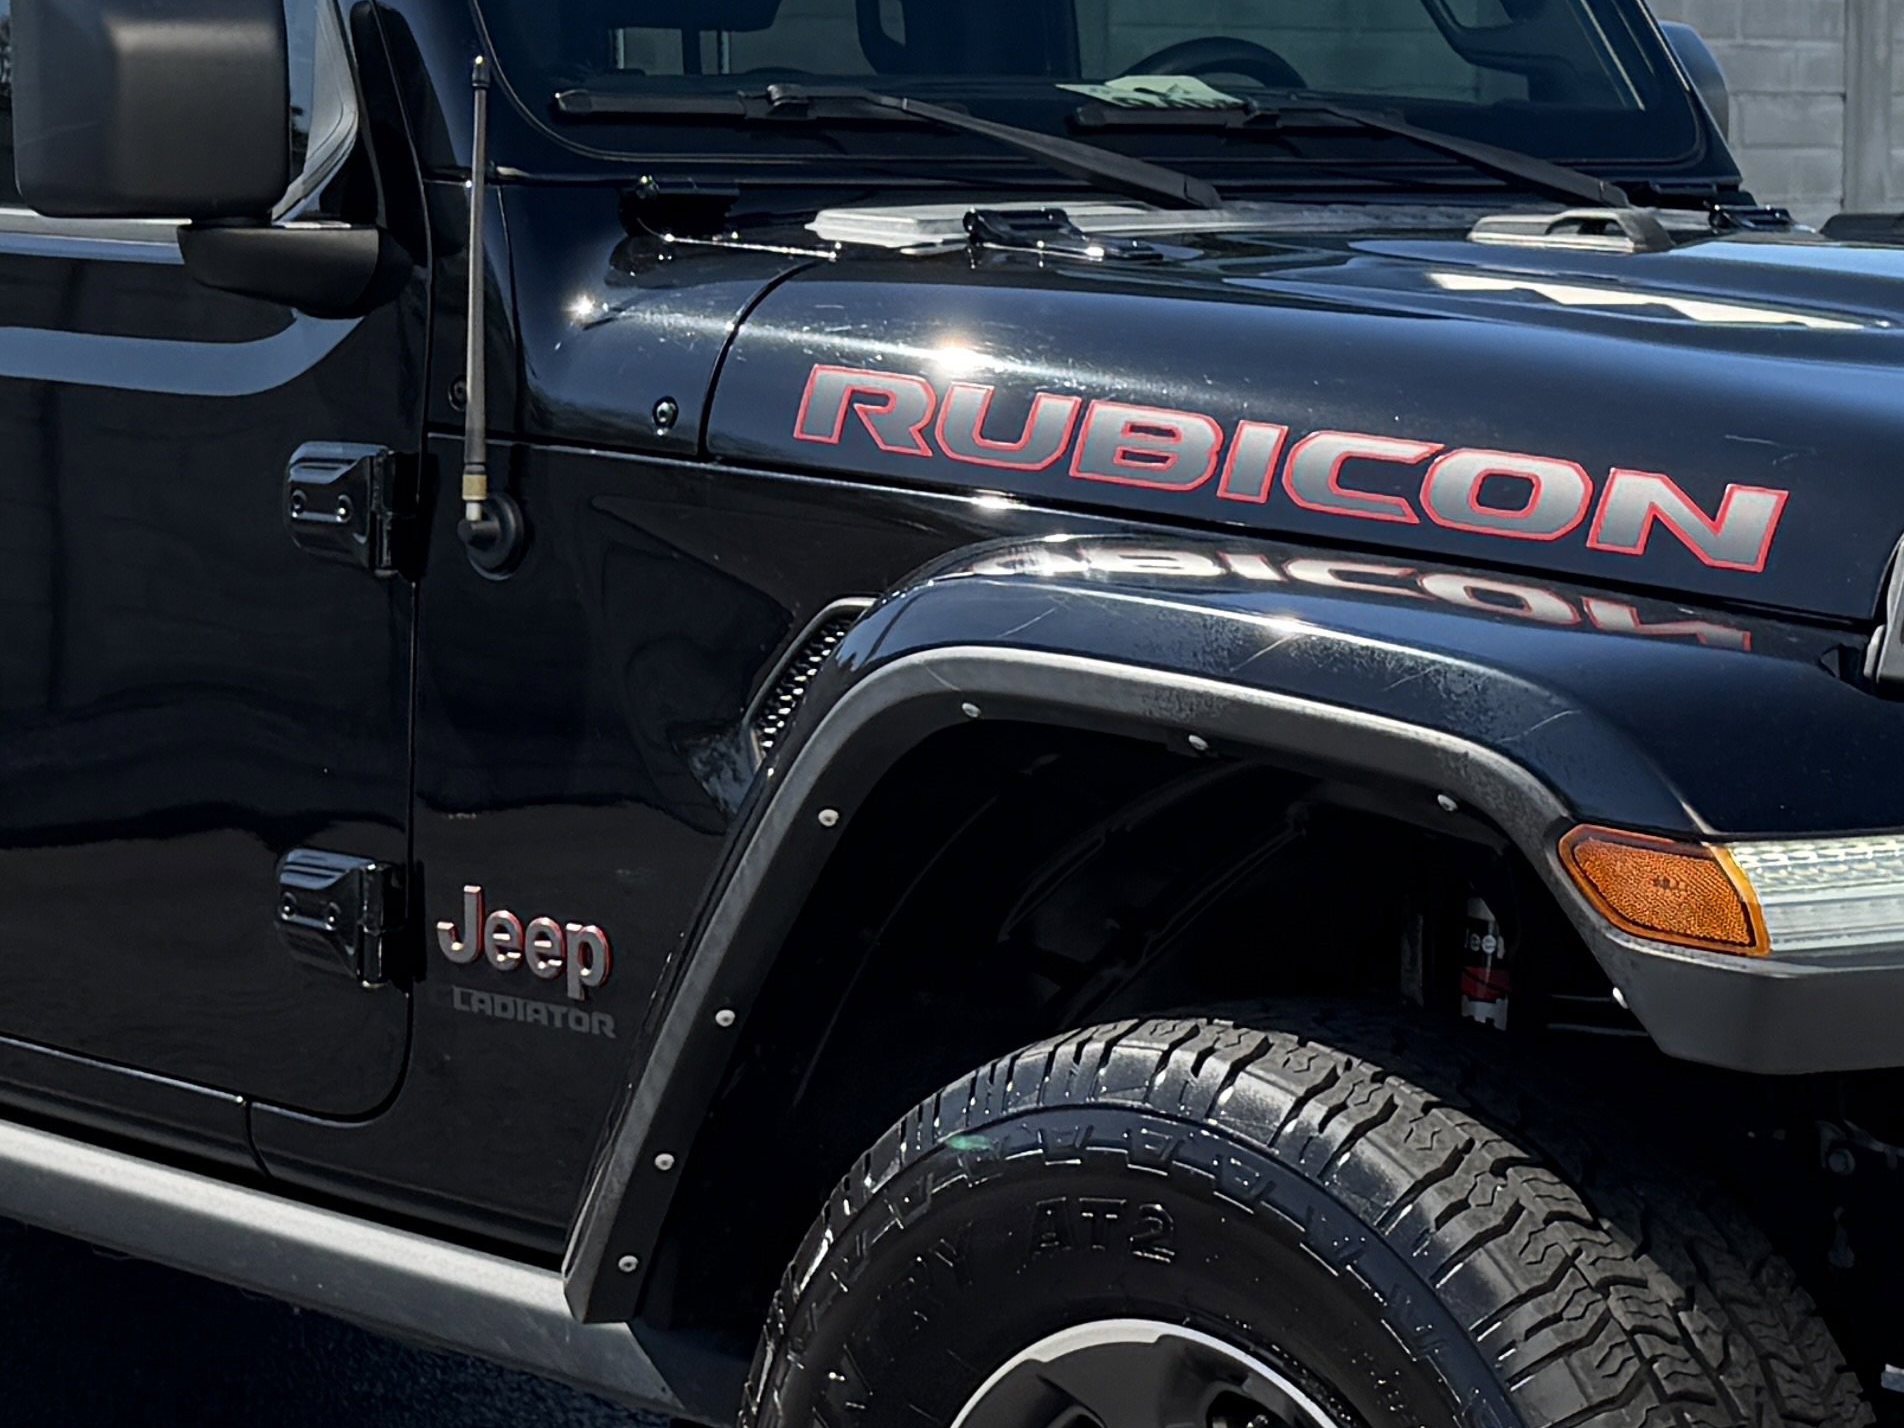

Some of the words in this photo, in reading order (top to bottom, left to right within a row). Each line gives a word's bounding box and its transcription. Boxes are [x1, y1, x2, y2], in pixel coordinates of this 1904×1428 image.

[792, 363, 1789, 572] RUBICON
[437, 885, 613, 1001] Jeep
[1027, 1194, 1178, 1266] AT2
